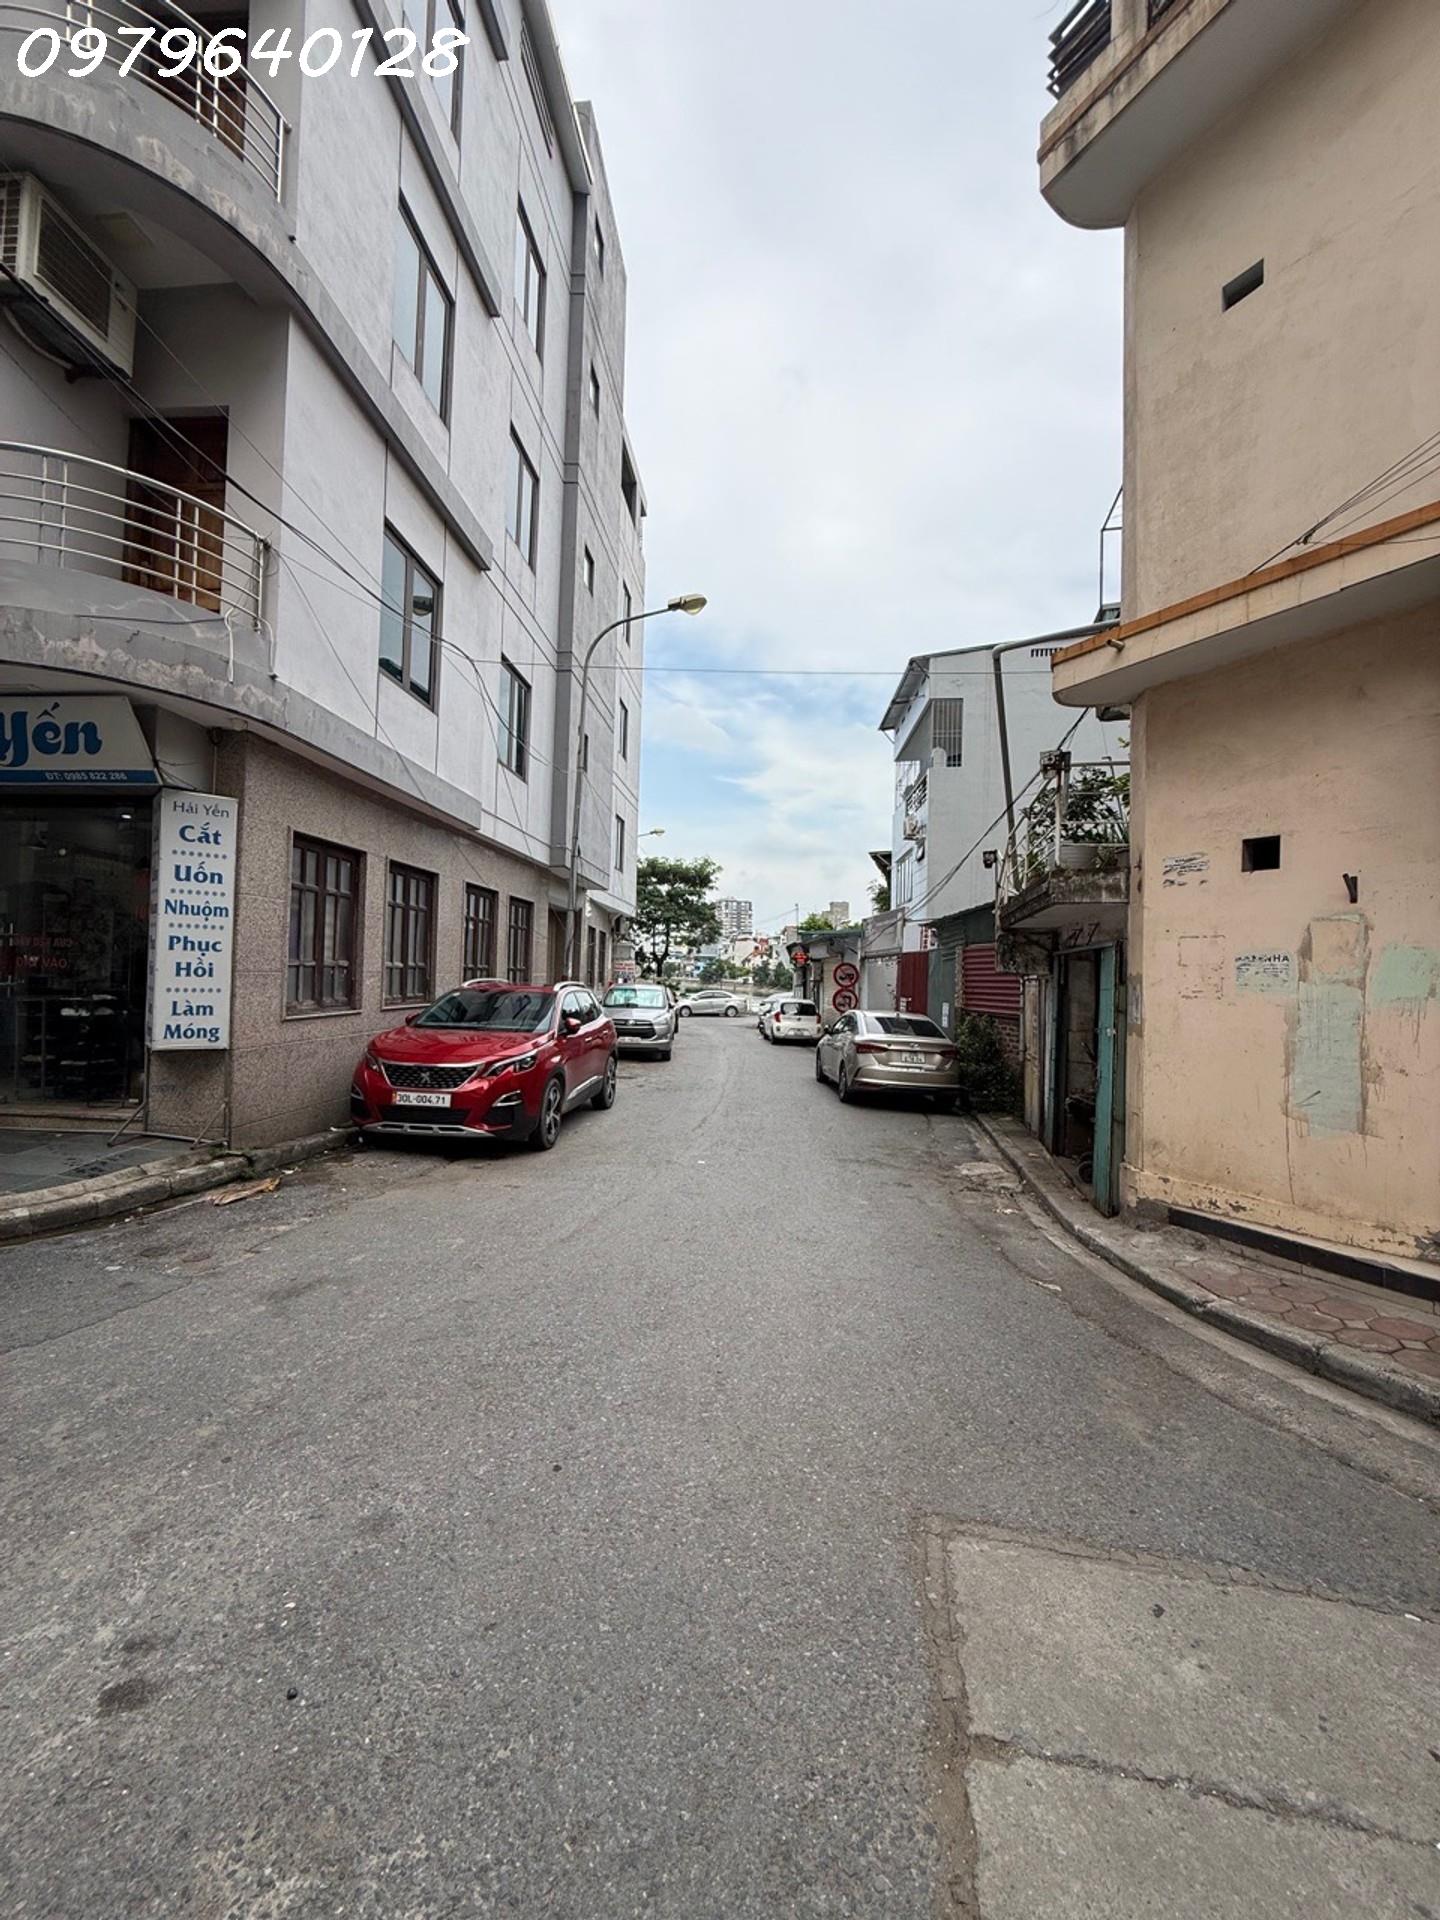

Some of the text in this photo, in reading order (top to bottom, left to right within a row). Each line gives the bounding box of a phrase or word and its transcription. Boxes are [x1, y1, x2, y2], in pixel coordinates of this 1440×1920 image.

[179, 822, 222, 845] Cắt
[174, 861, 223, 884] Uốn
[164, 898, 229, 921] Nhuộm
[168, 935, 223, 957] Phục
[175, 957, 214, 977] Hồi
[171, 1000, 214, 1016] Làm
[163, 1023, 220, 1043] Móng
